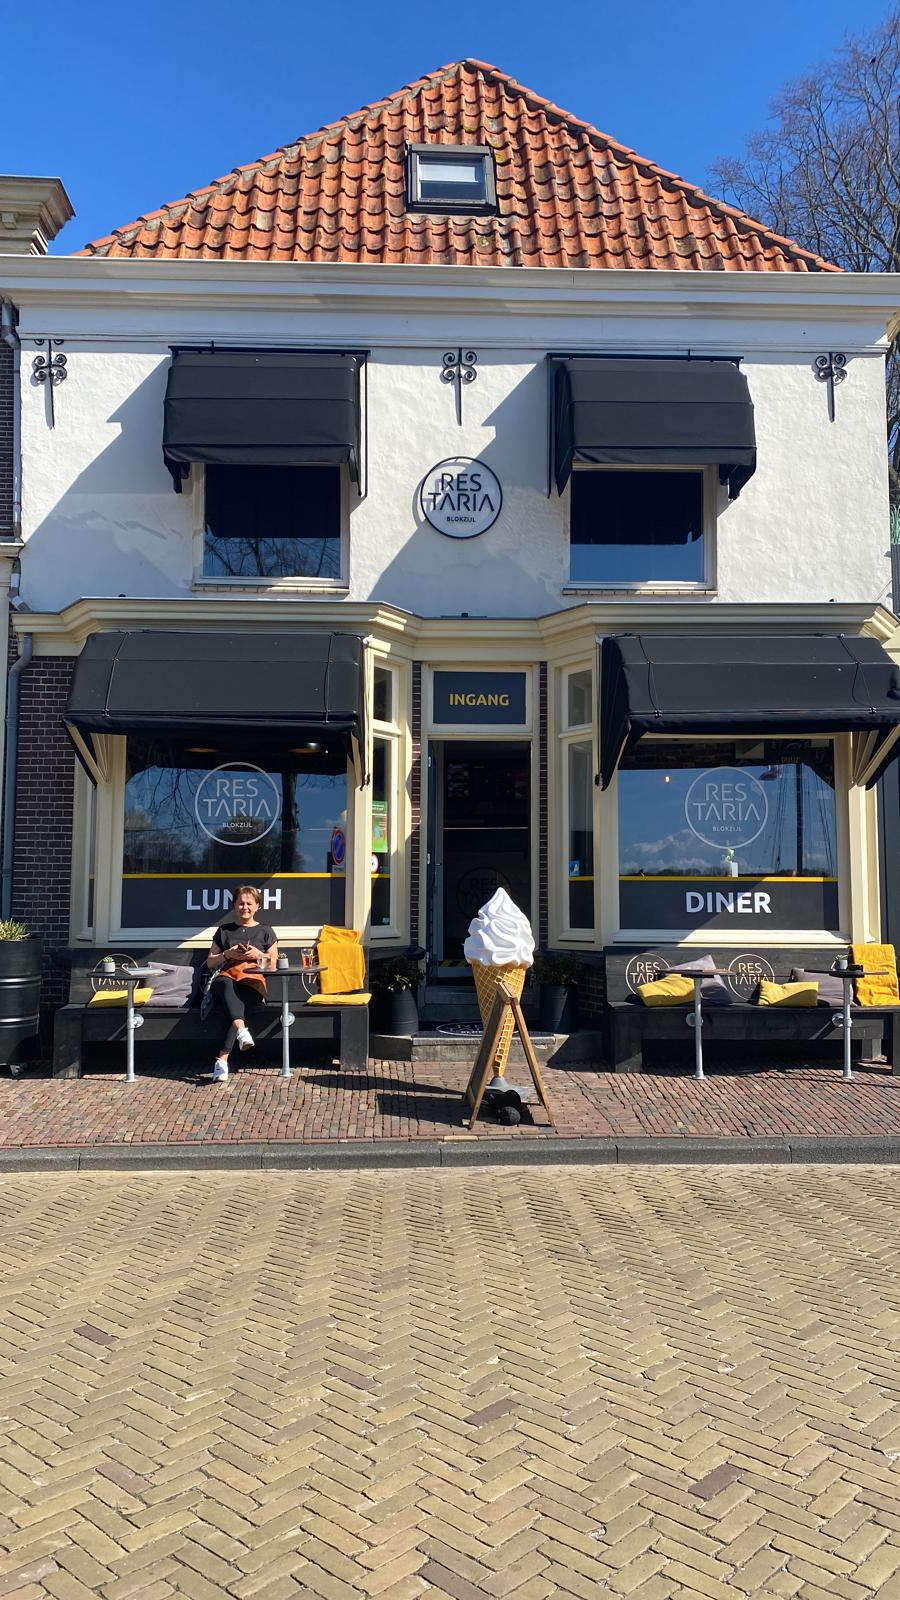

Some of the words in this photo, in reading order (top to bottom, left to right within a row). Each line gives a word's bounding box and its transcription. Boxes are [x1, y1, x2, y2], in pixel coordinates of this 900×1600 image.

[441, 473, 482, 492] RES
[428, 493, 495, 512] TARIA
[449, 693, 509, 706] INGANG
[216, 778, 259, 798] RES
[705, 783, 747, 802] RES
[203, 798, 272, 817] TARIA
[693, 803, 761, 821] TARIA
[186, 888, 282, 911] LUNH
[685, 891, 772, 914] DINER
[636, 961, 660, 973] RES
[738, 962, 763, 974] RES
